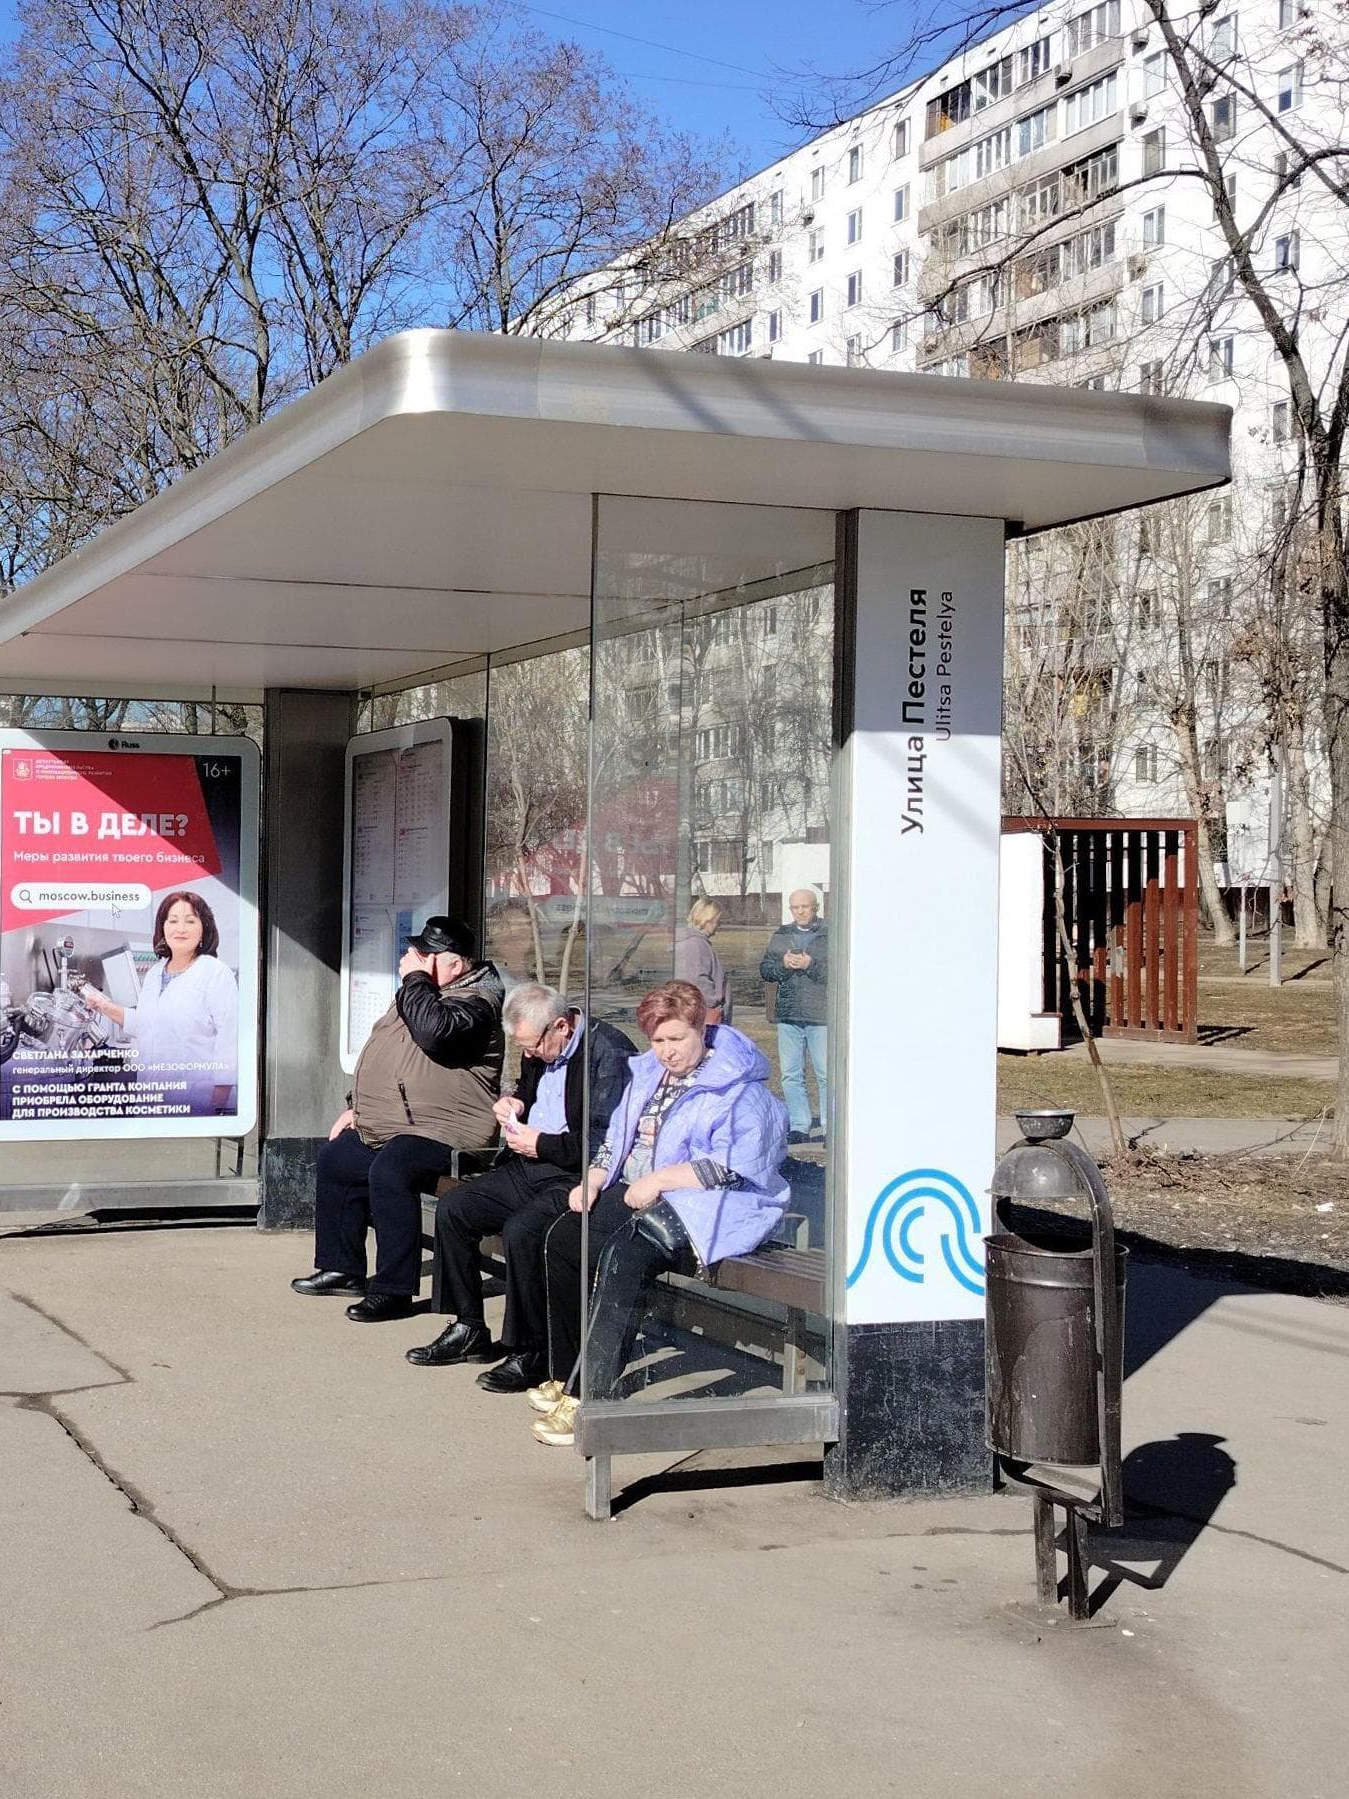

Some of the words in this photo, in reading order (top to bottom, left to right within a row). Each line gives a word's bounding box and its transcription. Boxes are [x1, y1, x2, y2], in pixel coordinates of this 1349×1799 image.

[936, 591, 956, 676] Pestelya
[902, 589, 927, 724] Пестеля
[935, 685, 952, 741] Ulitsa
[203, 762, 231, 777] 16+
[901, 735, 927, 834] Улица
[13, 811, 60, 835] ТЫ
[71, 811, 90, 836] В
[97, 812, 189, 840] ДЕЛЕ?
[13, 851, 49, 863] Меры
[53, 853, 109, 865] развития
[112, 853, 154, 863] твоего
[156, 851, 205, 864] бизнеса
[39, 890, 140, 902] moscow.business
[12, 1050, 68, 1060] СВЕТЛАНА
[71, 1049, 140, 1060] ЗАХАРЧЕНКО
[12, 1063, 74, 1076] генеральный
[75, 1064, 121, 1075] директор
[122, 1063, 146, 1072] ООО
[12, 1084, 21, 1094] С
[23, 1083, 85, 1095] ПОМОЩЬЮ
[87, 1082, 126, 1093] ГРАНТА
[128, 1080, 188, 1092] КОМПАНИЯ
[12, 1094, 77, 1107] ПРИОБРЕЛА
[78, 1092, 164, 1105] ОБОРУДОВАНИЕ
[12, 1106, 35, 1119] ДЛЯ
[37, 1105, 124, 1118] ПРОИЗВОДСТВА
[125, 1103, 191, 1115] КОСМЕТИКИ
